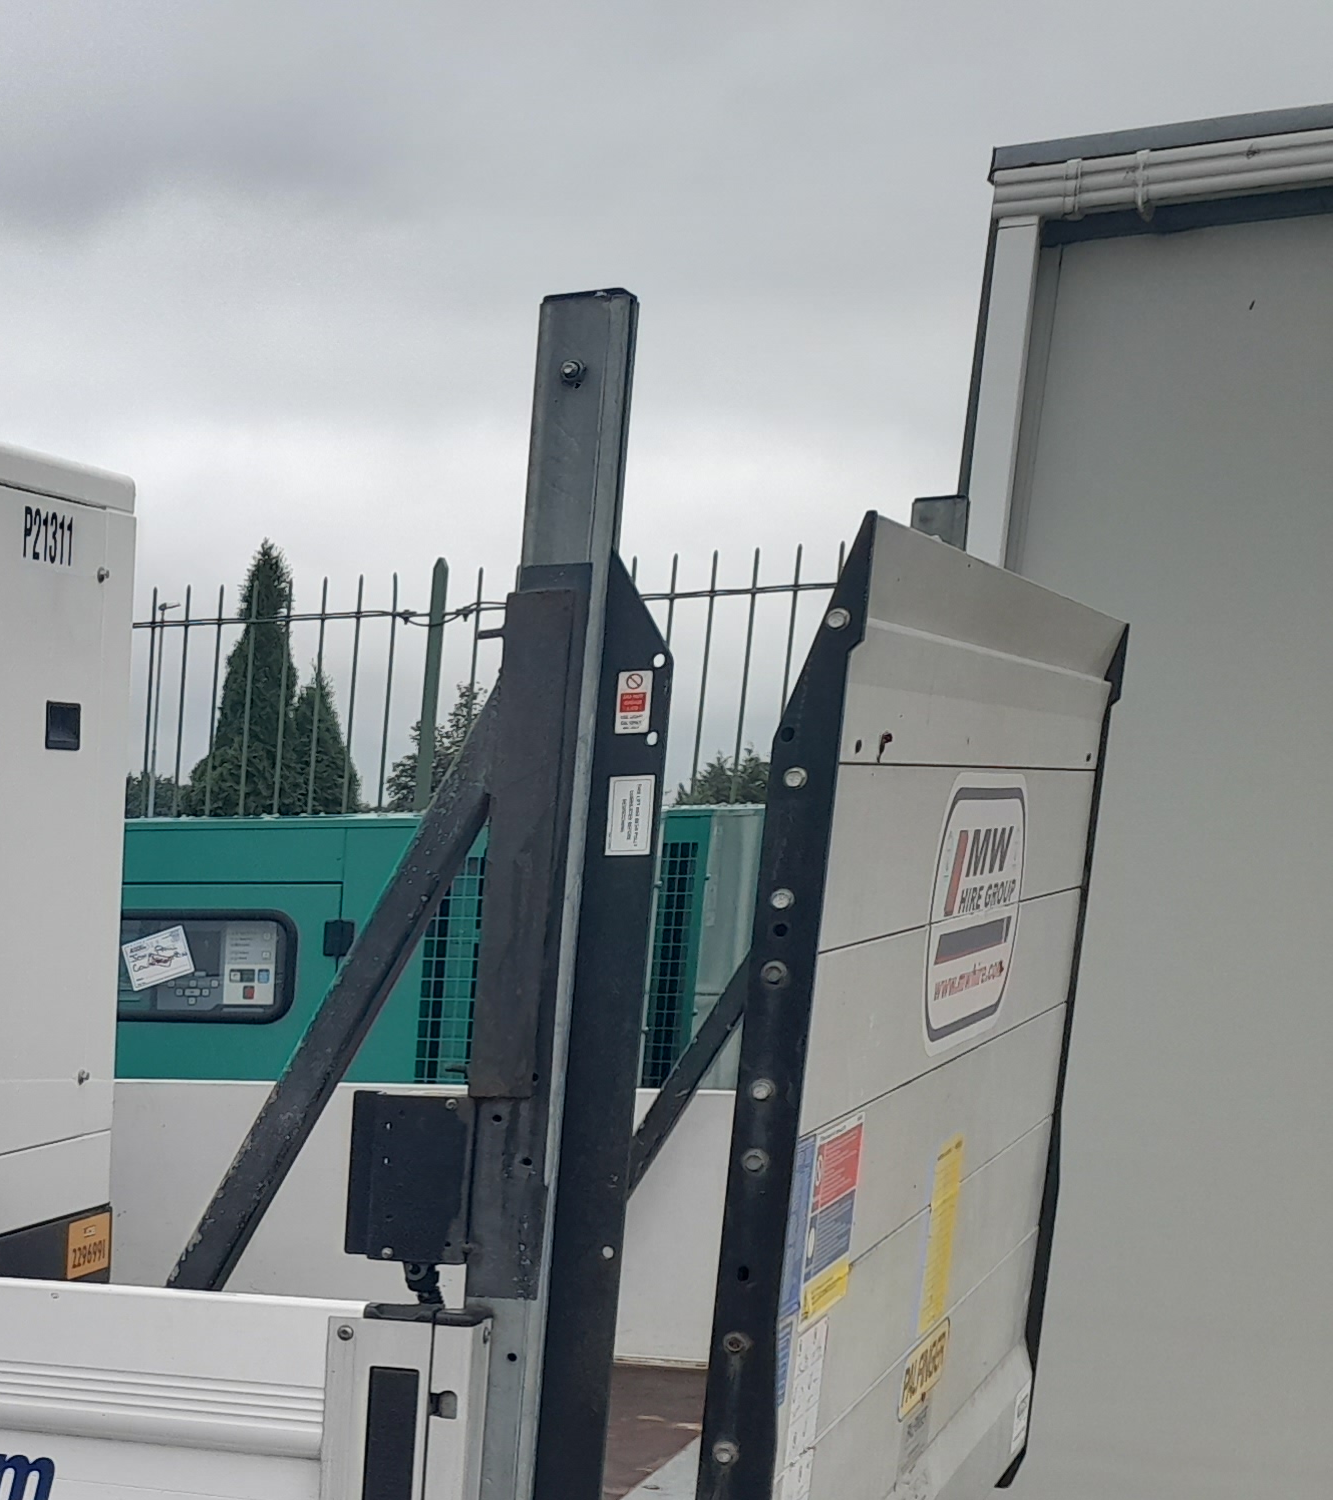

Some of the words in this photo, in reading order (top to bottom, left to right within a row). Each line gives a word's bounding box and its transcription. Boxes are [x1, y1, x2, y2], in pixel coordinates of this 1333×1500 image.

[23, 506, 73, 566] P21311
[965, 826, 1014, 877] MW
[957, 885, 984, 914] HIRE
[984, 879, 1016, 908] GROUP
